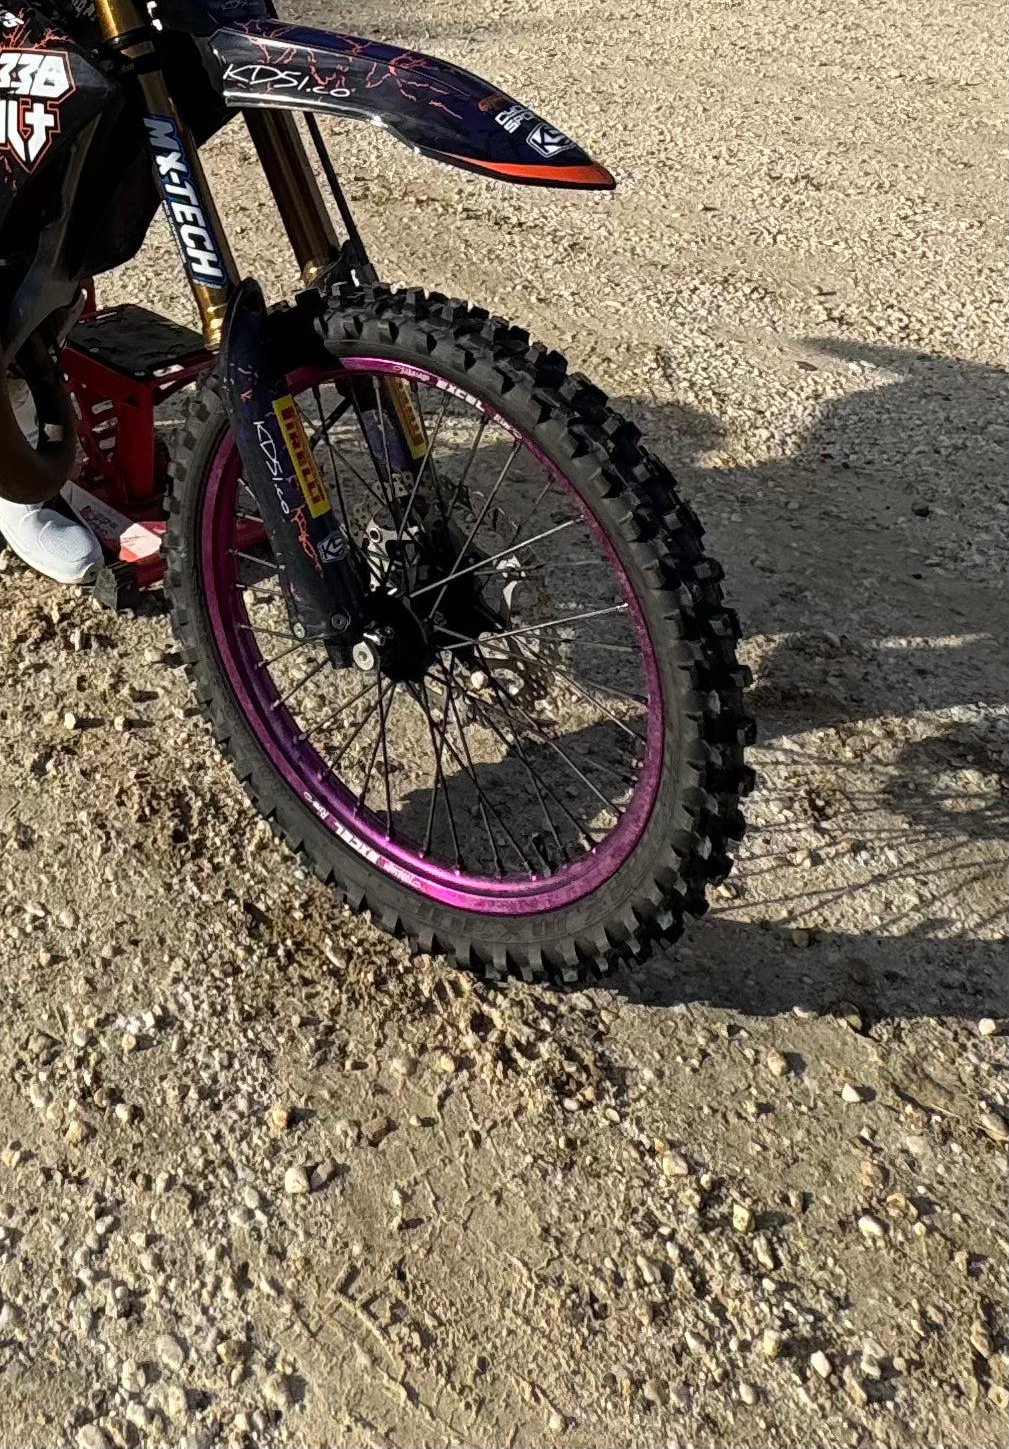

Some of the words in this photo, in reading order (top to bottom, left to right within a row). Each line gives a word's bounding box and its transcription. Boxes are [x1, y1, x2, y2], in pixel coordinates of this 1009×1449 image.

[143, 117, 224, 279] MX-TECH
[436, 379, 486, 412] EXCEL
[280, 407, 328, 505] PIRELLI
